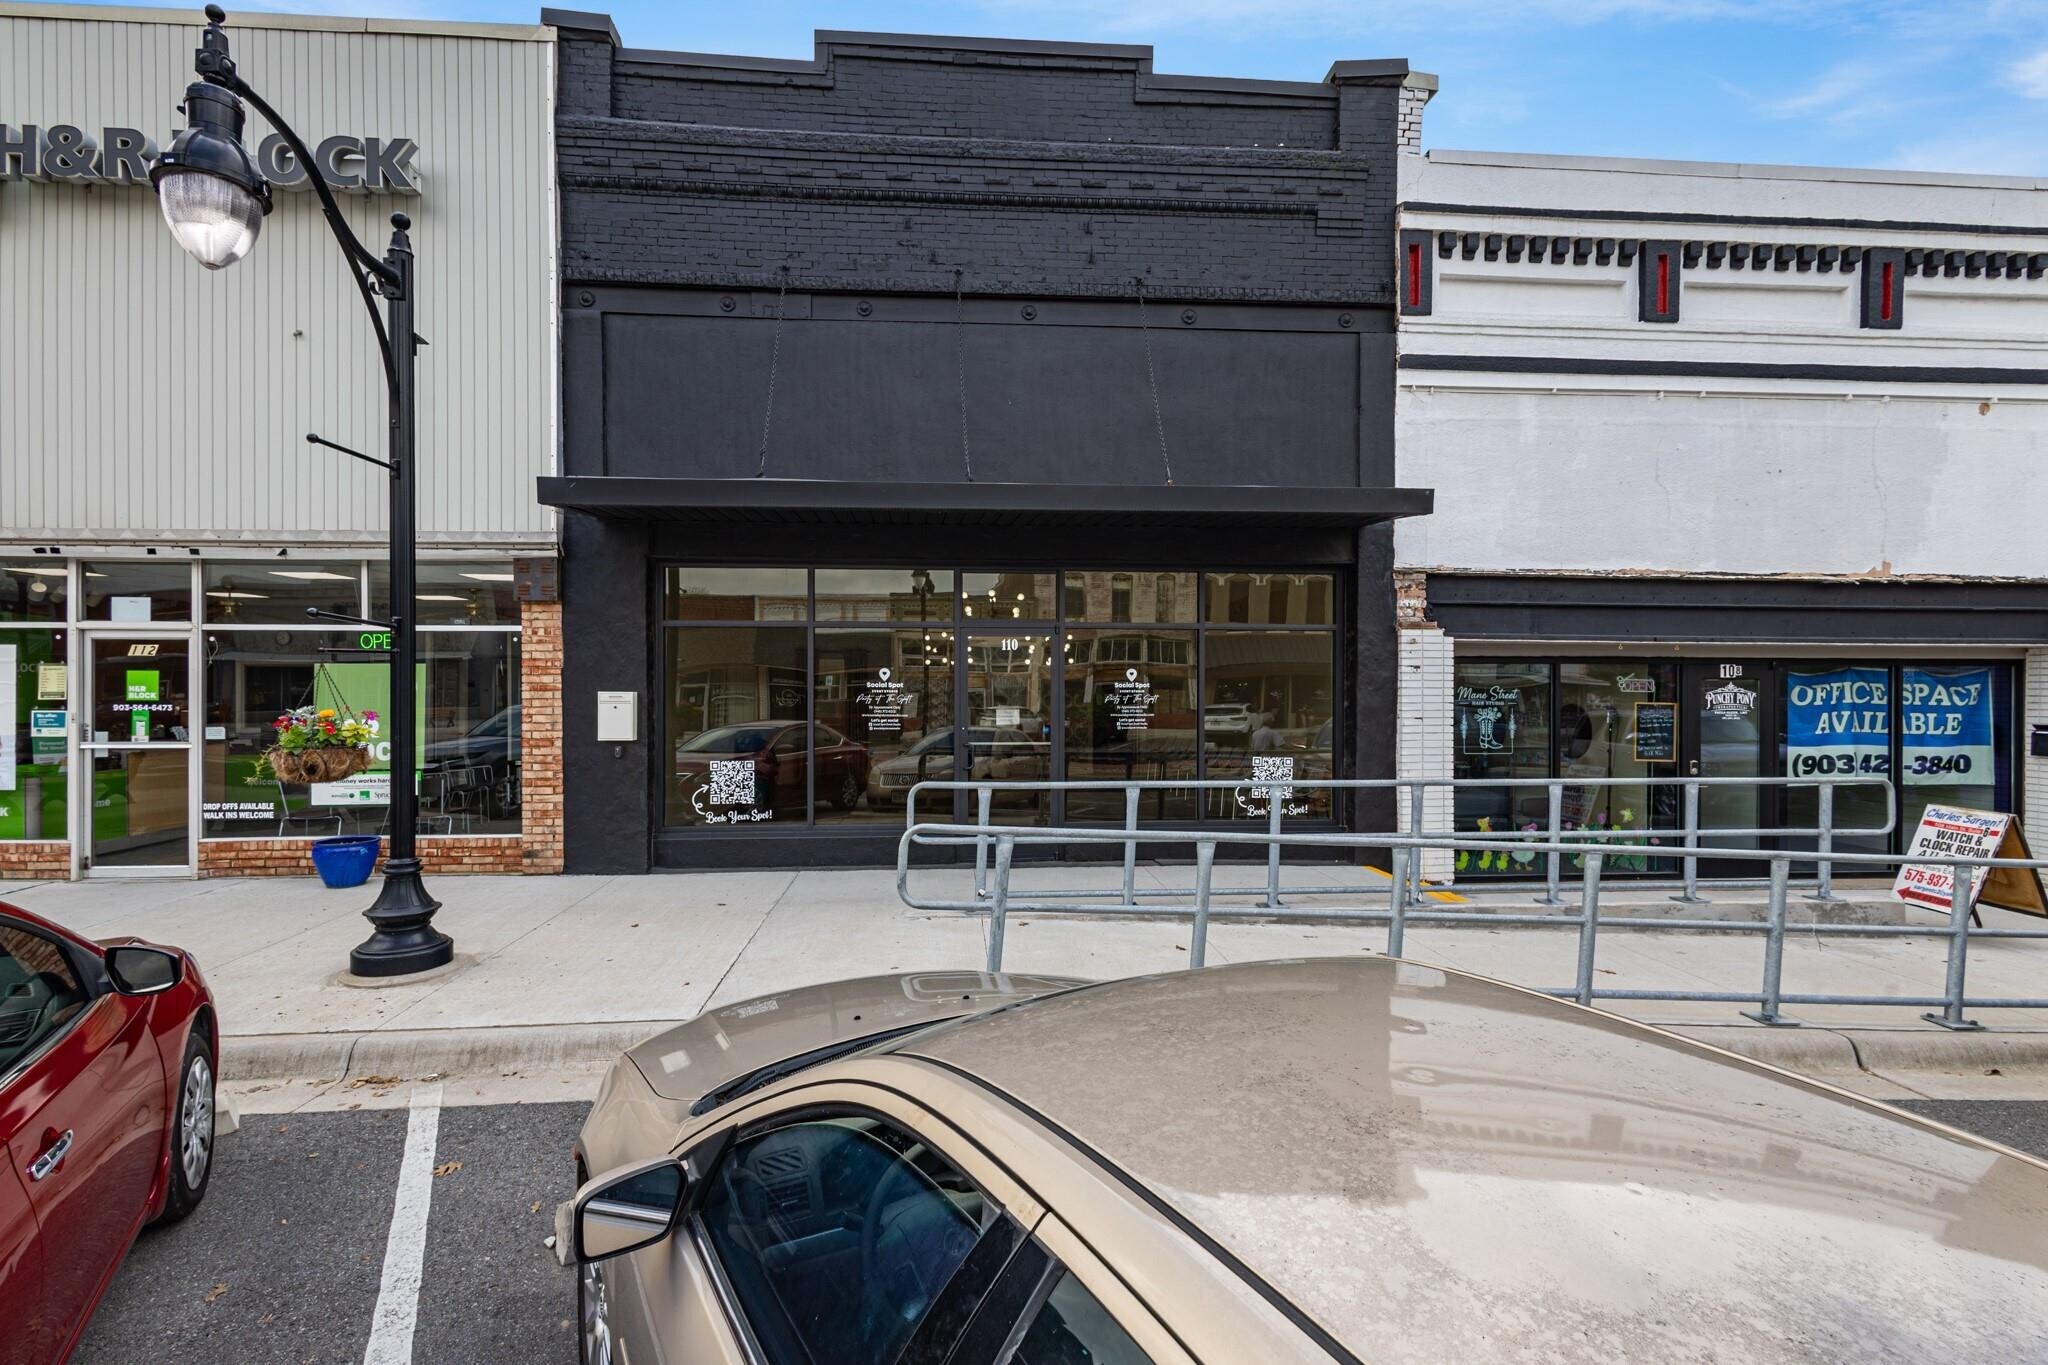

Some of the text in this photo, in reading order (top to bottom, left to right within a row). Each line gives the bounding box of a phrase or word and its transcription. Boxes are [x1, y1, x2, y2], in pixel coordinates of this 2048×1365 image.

[0, 124, 412, 189] H&R OCK
[360, 633, 391, 650] OPE
[1001, 639, 1019, 651] 110
[132, 645, 156, 656] 112
[1721, 664, 1741, 678] 108
[1458, 685, 1520, 701] Mane Street
[1736, 692, 1757, 709] PONY
[1790, 681, 1981, 706] OFFICE SPACE
[203, 802, 275, 811] DROP OFFS AVAILABLE
[225, 811, 238, 819] INS
[238, 811, 275, 819] WELCOME
[705, 808, 773, 824] Book Your Spot!
[1926, 808, 2004, 828] Charles Sargent
[1936, 829, 1983, 847] WATCH &
[1982, 827, 1990, 838] 6
[1920, 838, 1991, 858] CLOCK REPAIR
